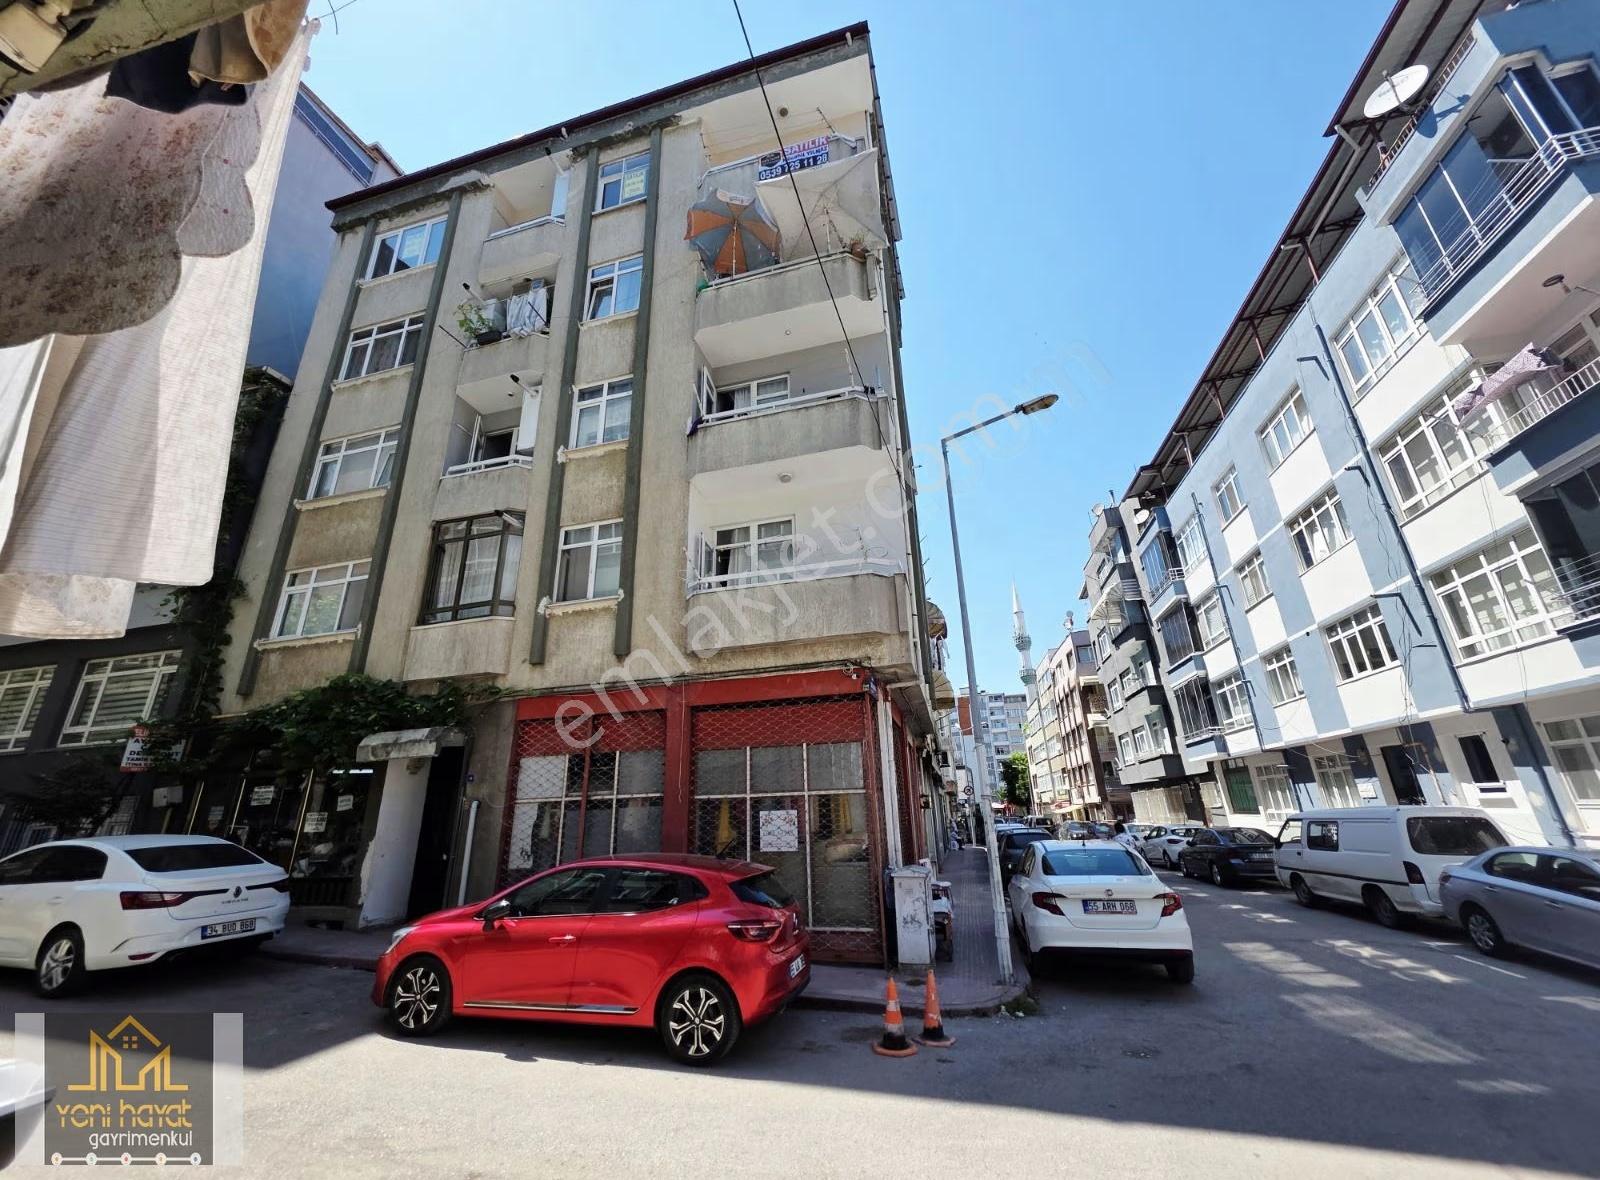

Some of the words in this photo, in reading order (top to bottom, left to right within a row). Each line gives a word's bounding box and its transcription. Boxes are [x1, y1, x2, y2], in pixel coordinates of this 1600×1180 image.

[784, 136, 829, 155] SATILIK
[760, 167, 782, 180] 0539
[783, 160, 800, 173] 725
[803, 157, 814, 167] 11
[207, 925, 218, 935] 34
